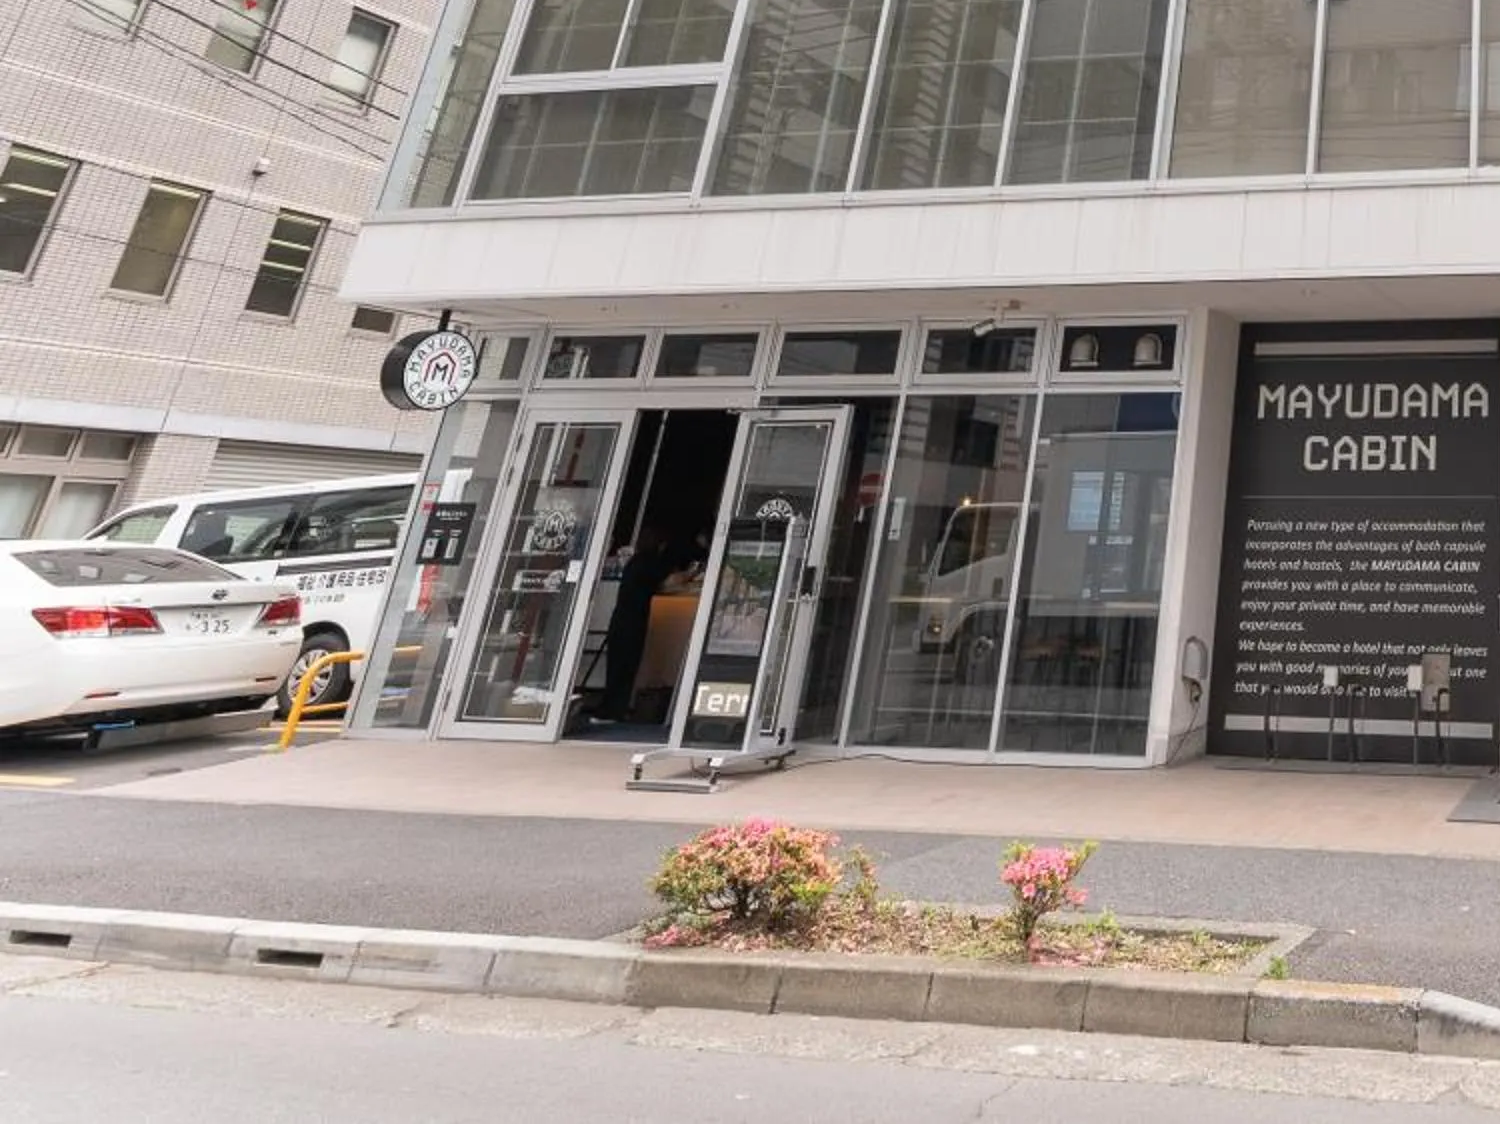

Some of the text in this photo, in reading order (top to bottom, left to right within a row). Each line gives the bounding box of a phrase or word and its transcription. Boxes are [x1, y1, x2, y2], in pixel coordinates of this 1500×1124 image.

[1257, 382, 1489, 419] MAYUDAMA
[1303, 434, 1437, 471] CABIN
[1248, 519, 1293, 532] Pursuing
[1305, 522, 1329, 531] new
[1331, 520, 1355, 533] type
[1357, 519, 1370, 533] of
[1371, 519, 1460, 531] accommodation
[1461, 519, 1485, 532] that
[1245, 539, 1487, 553] incorporates the advantages of both capsule
[1244, 558, 1277, 570] hotels
[1279, 559, 1300, 570] and
[1349, 559, 1368, 571] the
[1371, 560, 1441, 571] MAYUDAMA
[1443, 560, 1480, 572] CABIN
[1241, 579, 1288, 593] provides
[1291, 581, 1312, 592] you
[1314, 579, 1339, 591] with
[1351, 580, 1380, 593] place
[1384, 581, 1396, 592] to
[1241, 599, 1271, 612] enjoy
[1271, 601, 1297, 613] your
[1297, 599, 1336, 613] private
[1369, 600, 1391, 613] and
[1393, 601, 1419, 613] have
[1421, 602, 1486, 614] memorable
[1239, 639, 1255, 651] We
[1258, 639, 1284, 653] hope
[1285, 641, 1296, 652] to
[1300, 640, 1340, 653] become
[1352, 641, 1380, 654] hotel
[1382, 641, 1404, 654] that
[1407, 644, 1426, 655] not
[1453, 644, 1488, 657] leaves
[1236, 662, 1256, 674] you
[1260, 660, 1283, 673] with
[1285, 661, 1314, 675] good
[1373, 664, 1386, 678] of
[1465, 668, 1487, 678] one
[1235, 681, 1259, 693] that
[1283, 682, 1319, 695] would
[1369, 686, 1381, 697] to
[1383, 686, 1407, 697] visit
